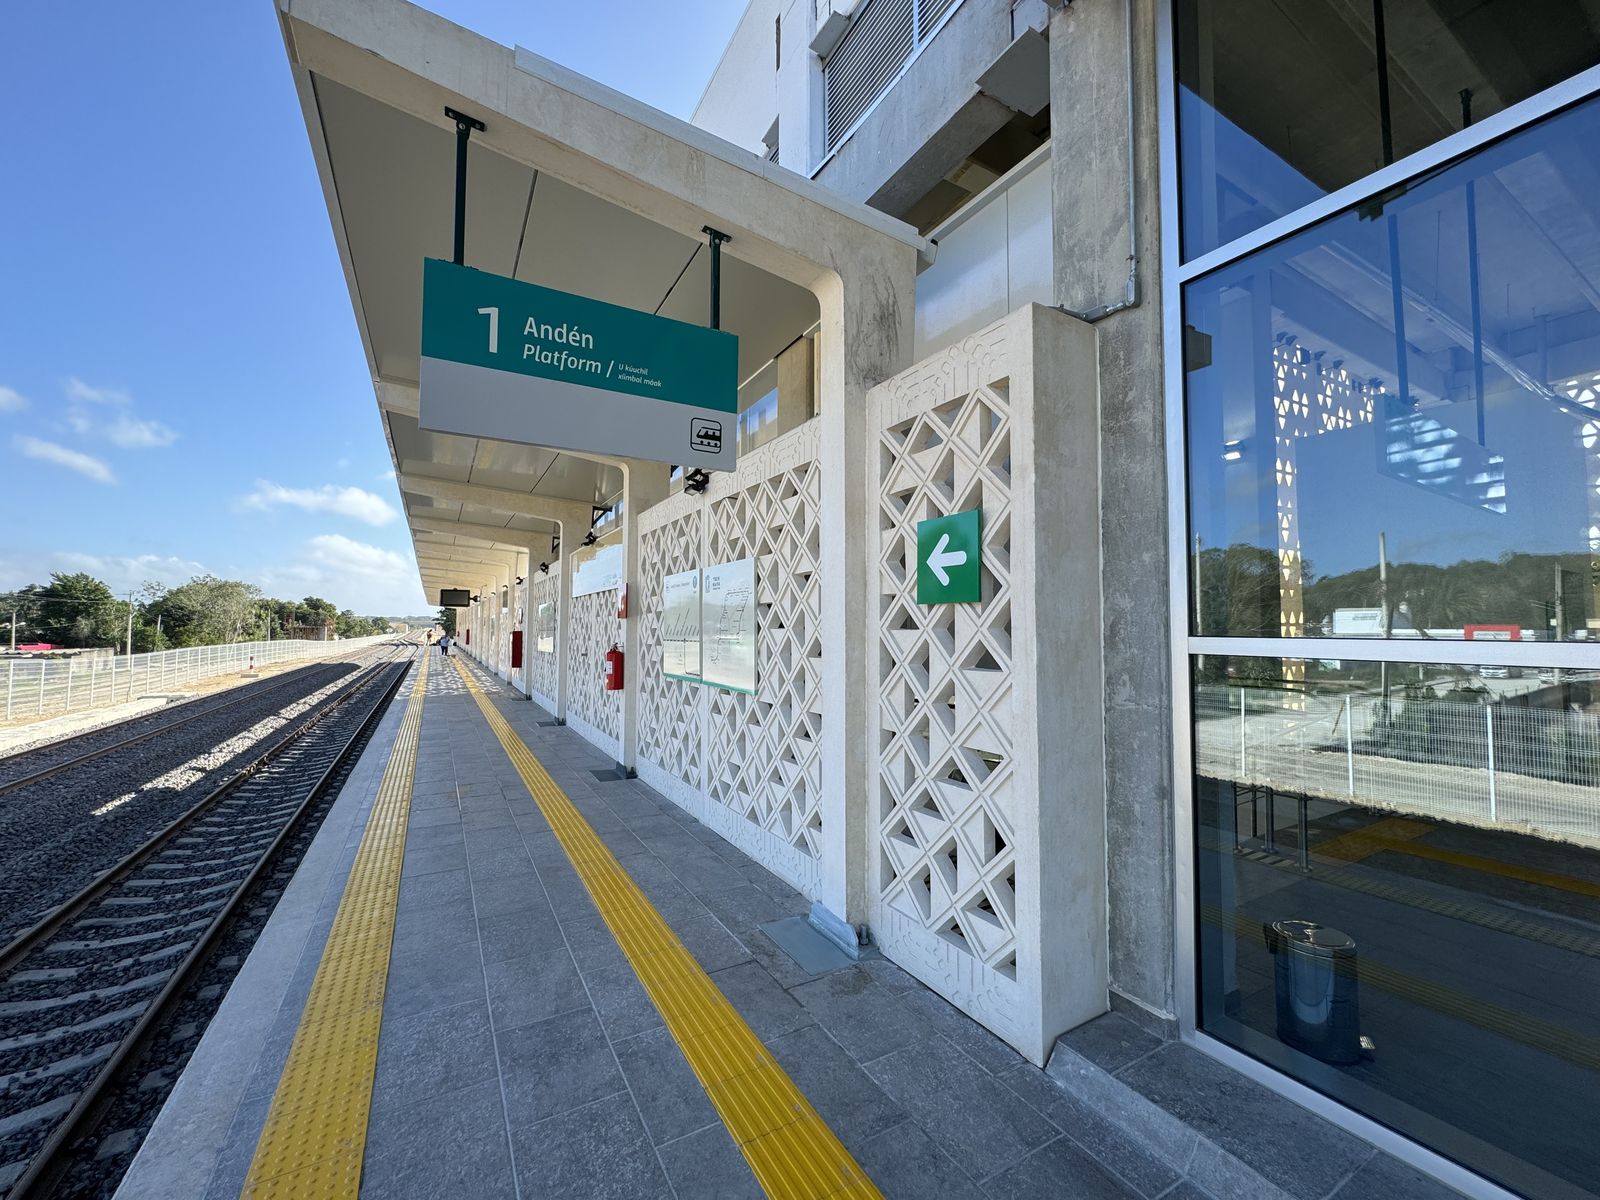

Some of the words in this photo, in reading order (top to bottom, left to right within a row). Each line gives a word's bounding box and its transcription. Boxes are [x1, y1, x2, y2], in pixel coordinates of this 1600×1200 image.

[477, 306, 499, 354] 1
[523, 316, 594, 350] Andén
[522, 343, 602, 374] Platform
[618, 363, 624, 371] U
